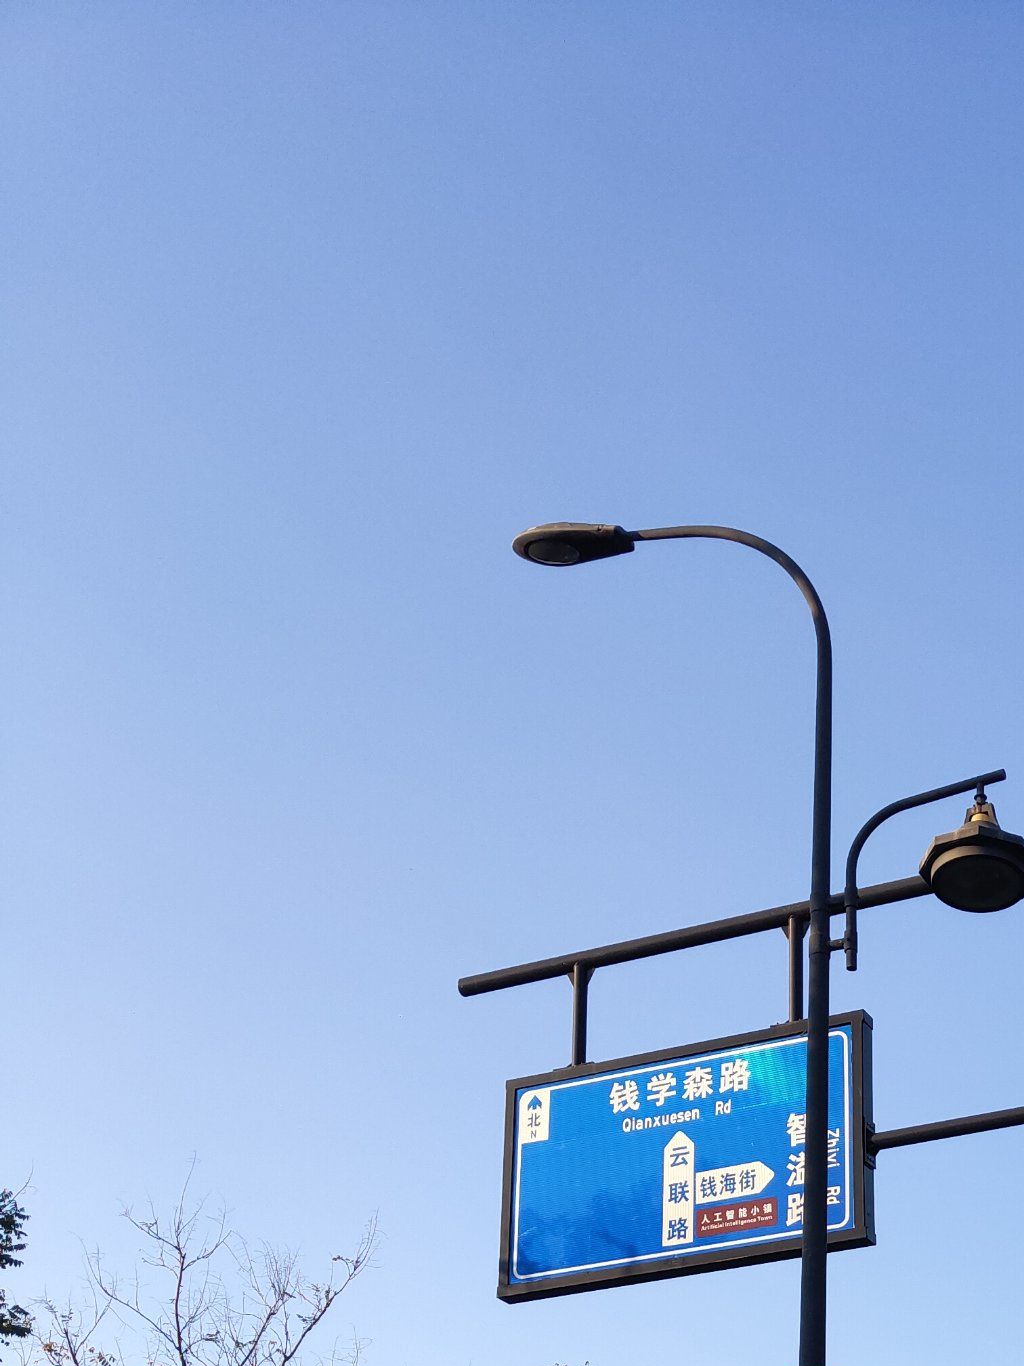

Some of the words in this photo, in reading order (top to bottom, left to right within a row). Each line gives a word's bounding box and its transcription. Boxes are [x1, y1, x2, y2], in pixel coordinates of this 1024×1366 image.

[609, 1059, 751, 1114] 钱学森路
[527, 1112, 541, 1127] 北
[622, 1108, 700, 1132] Qianxuesen
[715, 1099, 732, 1116] Rd
[530, 1129, 537, 1139] N
[666, 1145, 690, 1241] 云联路
[700, 1168, 757, 1198] 钱海街
[827, 1186, 840, 1205] Rd
[701, 1203, 772, 1224] 人工智能小镇
